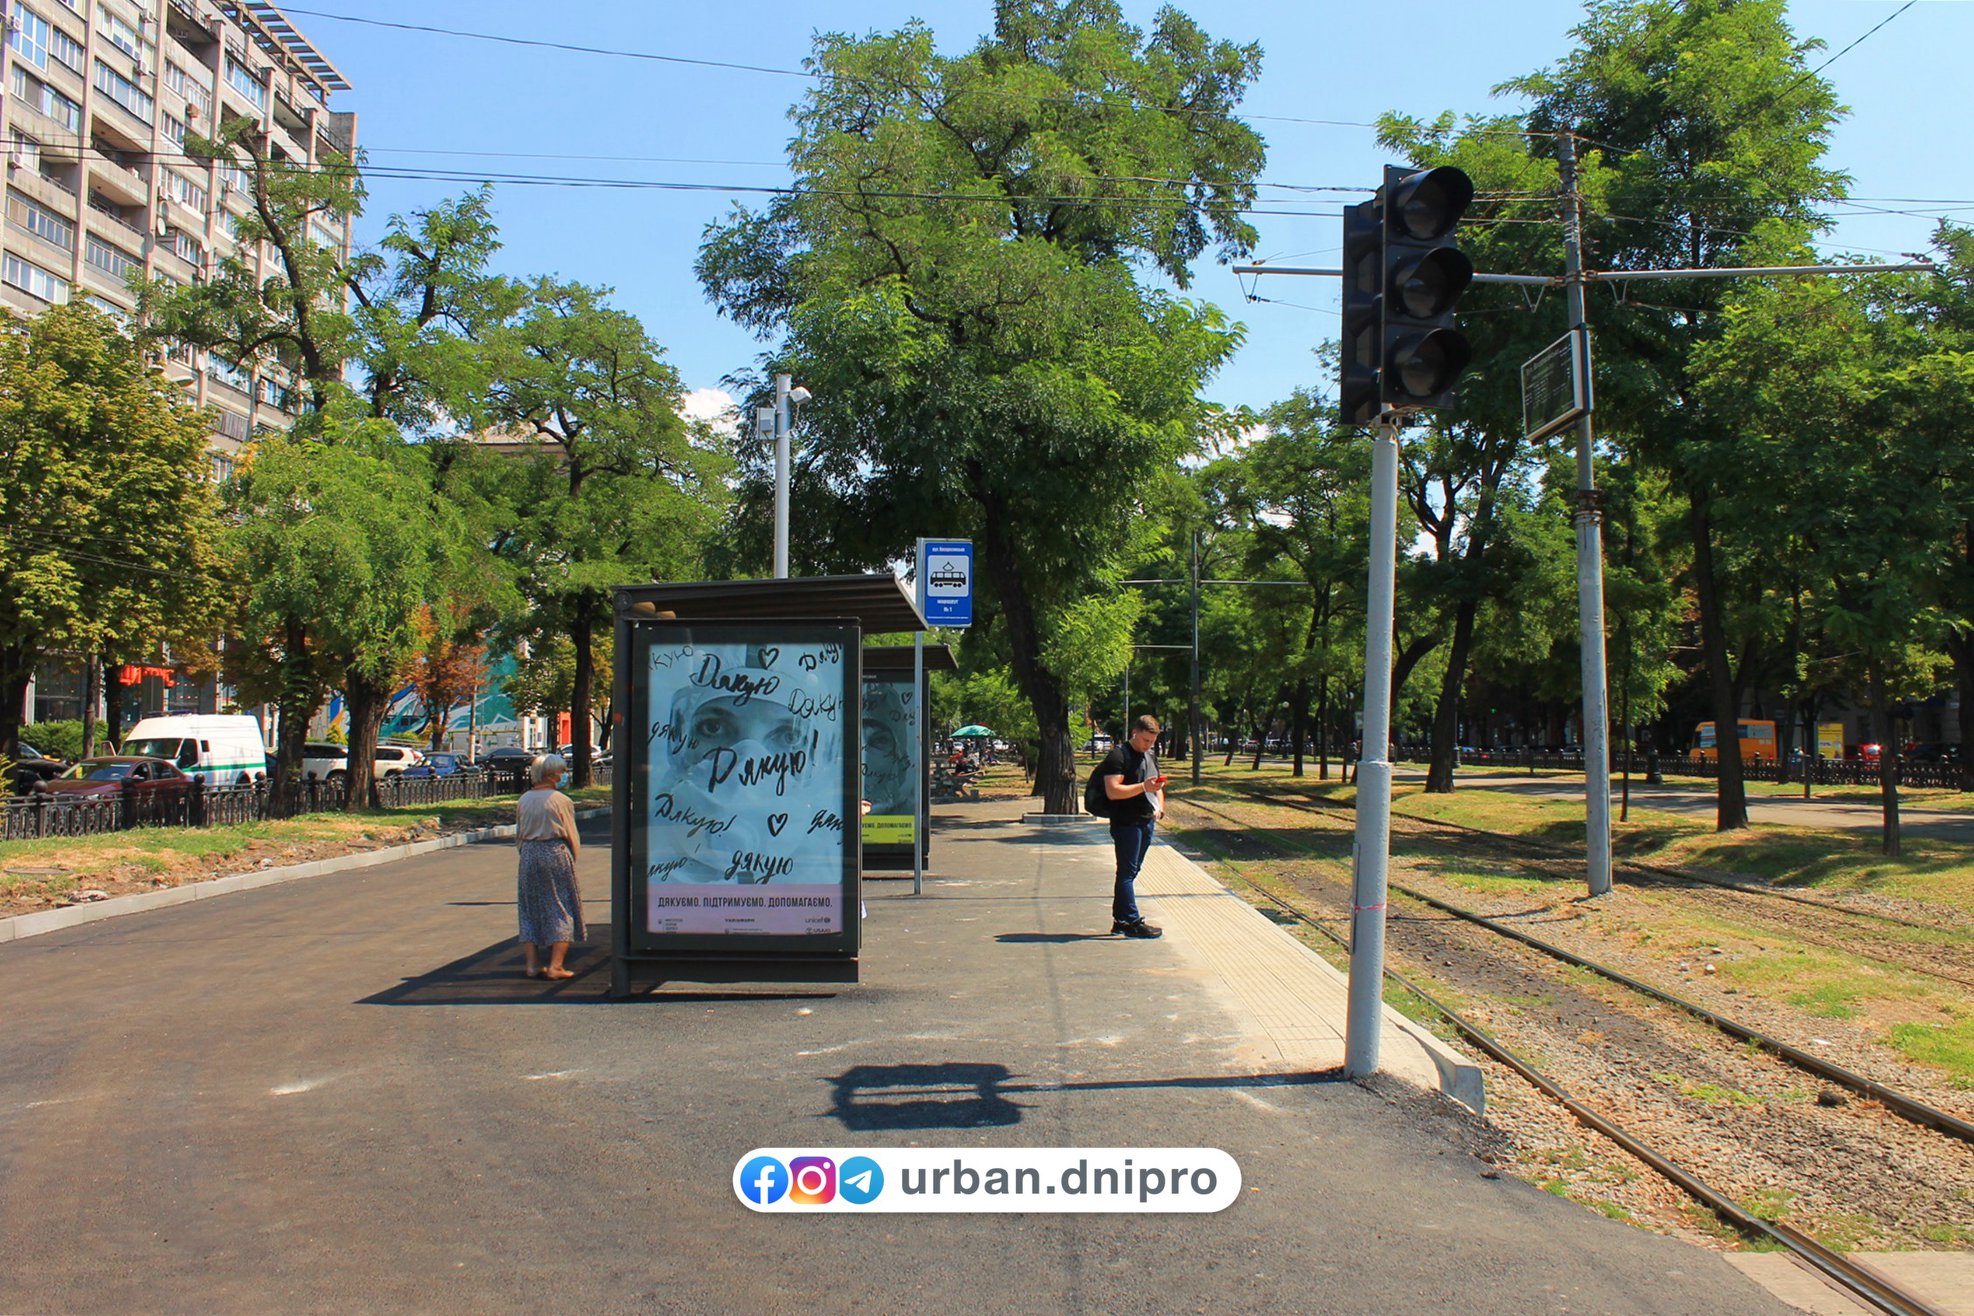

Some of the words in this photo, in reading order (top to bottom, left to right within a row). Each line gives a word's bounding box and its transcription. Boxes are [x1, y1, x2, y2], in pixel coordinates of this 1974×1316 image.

[725, 850, 793, 884] дякую
[658, 896, 700, 908] ДЯКУЄМО.
[703, 896, 766, 908] ПІДТРИМУЄМО.
[768, 896, 832, 908] ДОПОМАГАЄМО.
